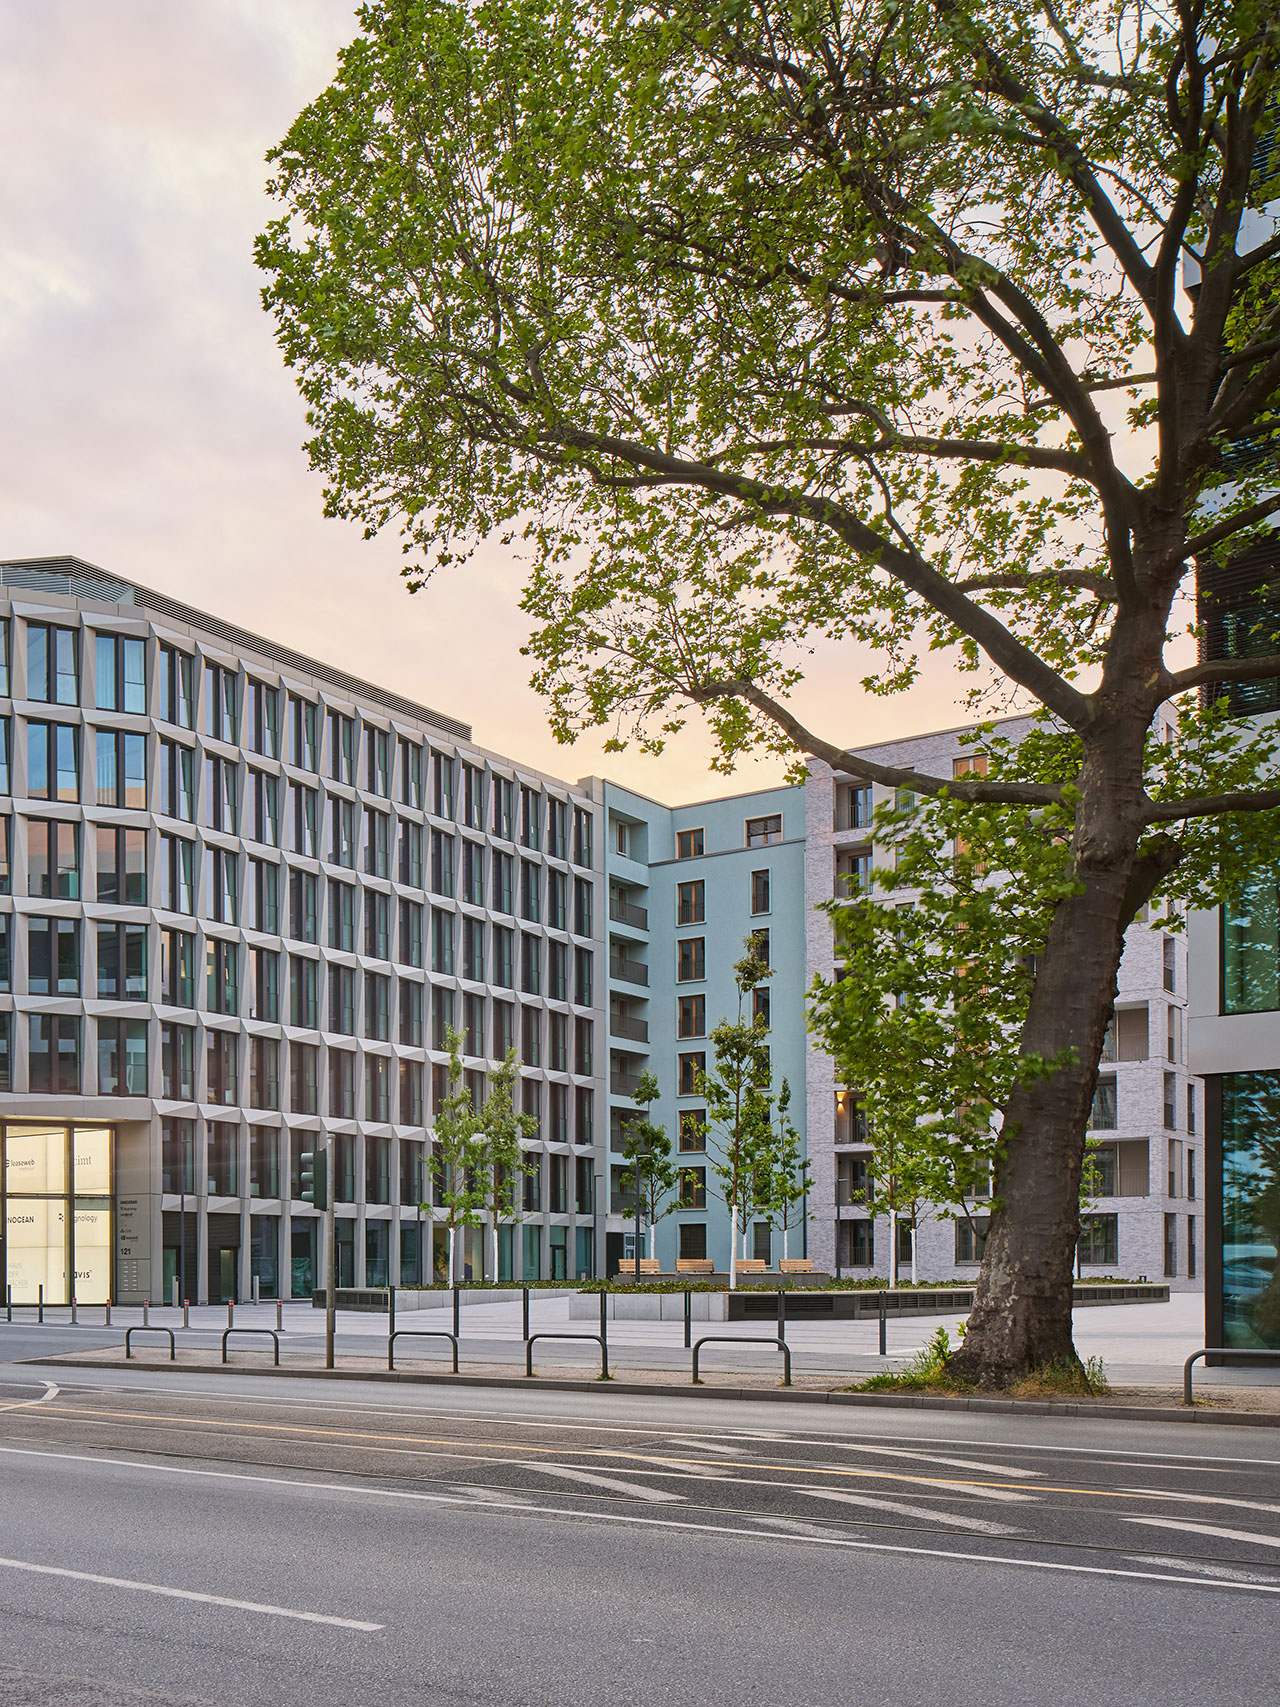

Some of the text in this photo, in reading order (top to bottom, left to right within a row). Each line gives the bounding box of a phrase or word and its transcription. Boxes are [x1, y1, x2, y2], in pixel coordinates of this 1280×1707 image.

[7, 1216, 35, 1224] NOCEAN
[74, 1214, 98, 1223] gnology
[120, 1247, 131, 1255] 121
